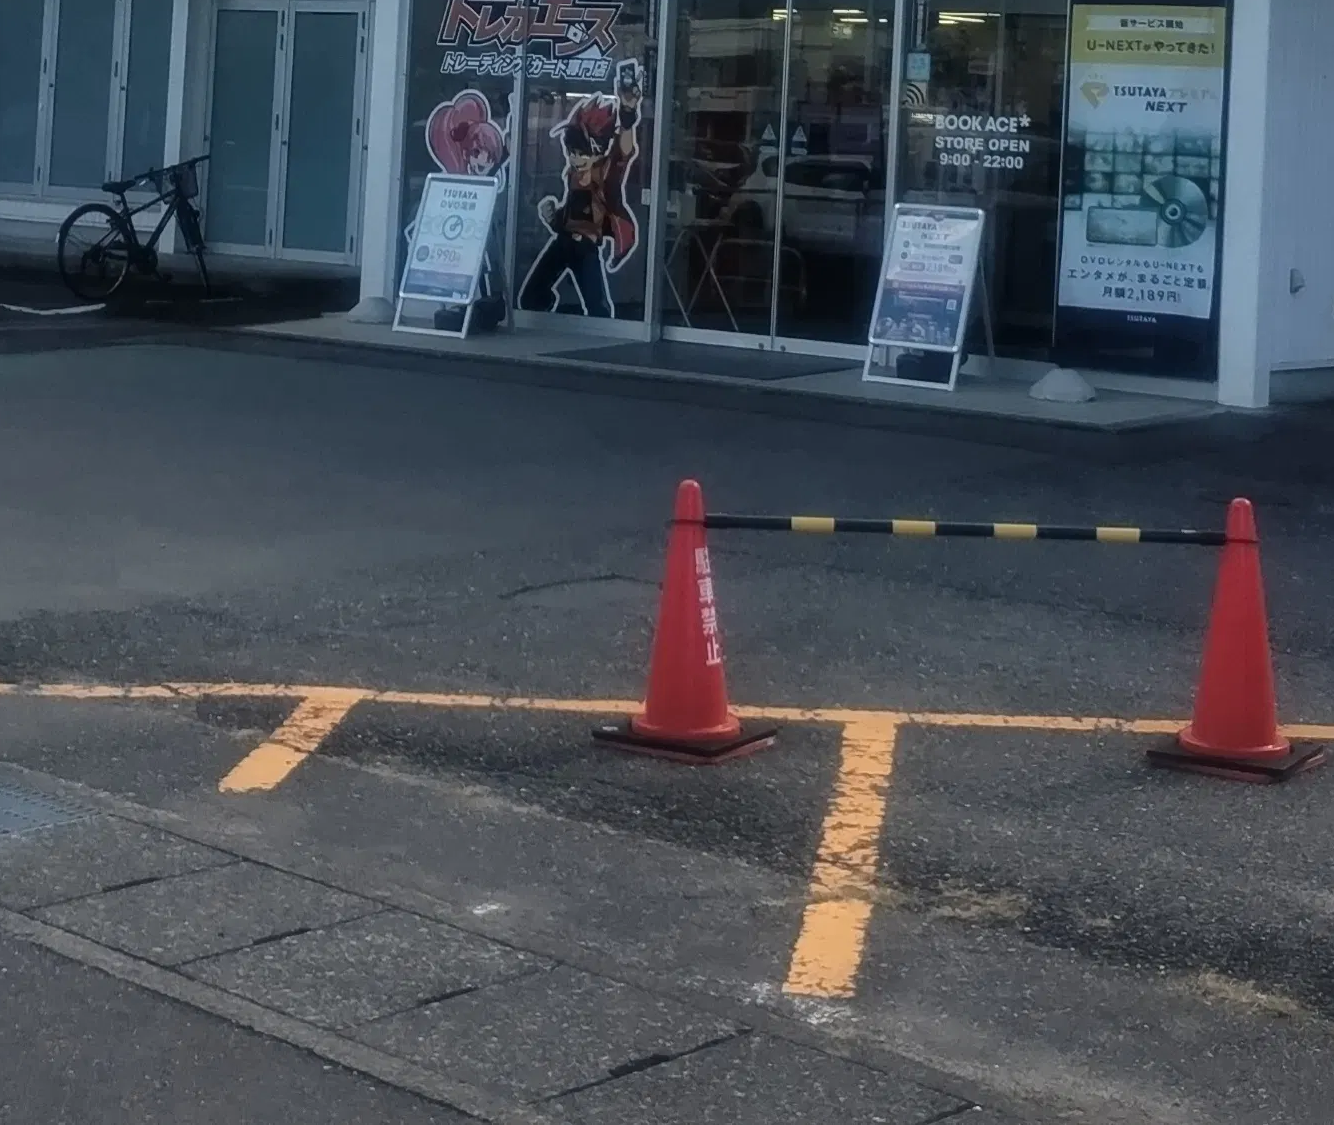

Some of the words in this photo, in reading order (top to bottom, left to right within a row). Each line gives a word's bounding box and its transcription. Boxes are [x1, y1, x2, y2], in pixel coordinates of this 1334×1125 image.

[1113, 86, 1166, 98] TSUTAYA
[1145, 101, 1187, 113] NEXT
[935, 114, 982, 132] BOOK
[935, 135, 983, 151] STORE
[988, 138, 1030, 153] OPEN
[939, 153, 970, 166] 9:00
[983, 155, 1024, 169] 22:00
